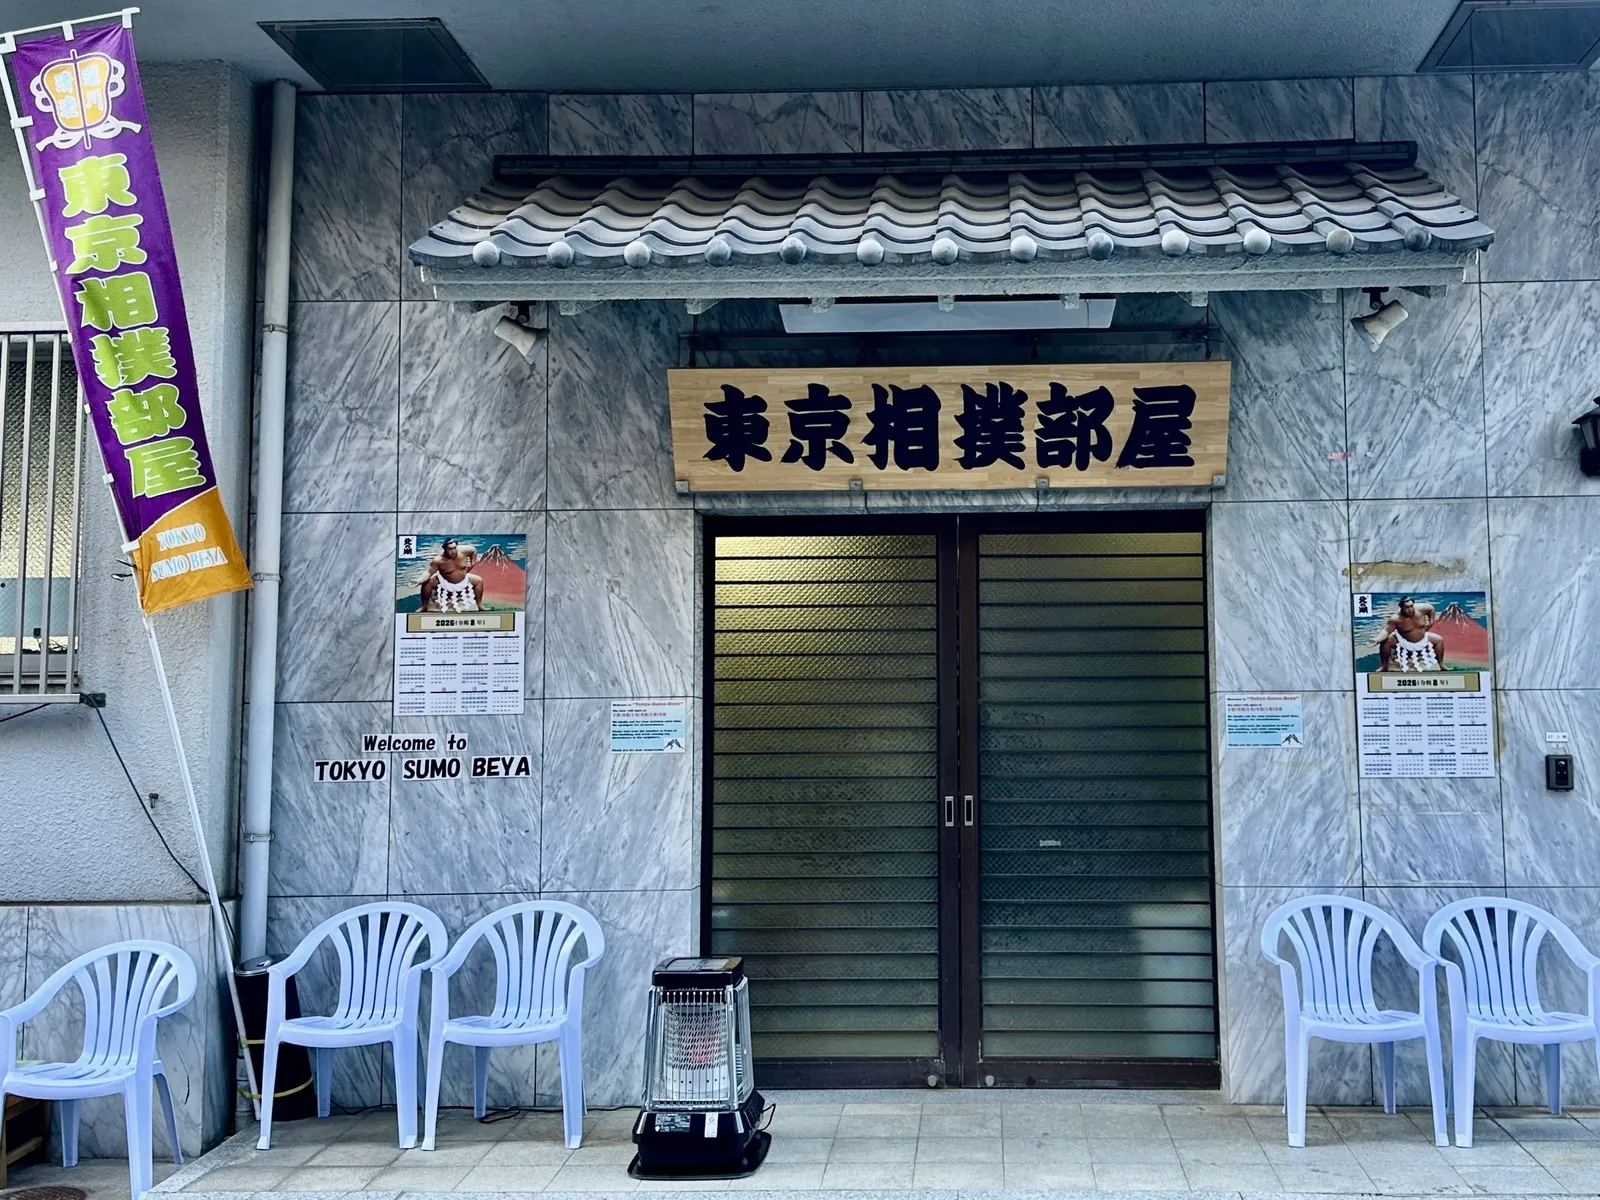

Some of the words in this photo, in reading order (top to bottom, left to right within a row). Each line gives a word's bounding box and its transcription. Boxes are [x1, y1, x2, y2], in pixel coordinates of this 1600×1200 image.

[57, 152, 207, 499] 東京相撲部屋
[702, 381, 1197, 472] 東京相撲部屋
[156, 523, 206, 551] TOKYO
[151, 555, 190, 583] SUMO
[187, 547, 228, 571] BEYA
[364, 735, 436, 751] Welcome
[448, 734, 467, 751] to
[315, 760, 386, 781] TOKYO
[403, 757, 461, 779] SUMO
[472, 756, 531, 777] BEYA
